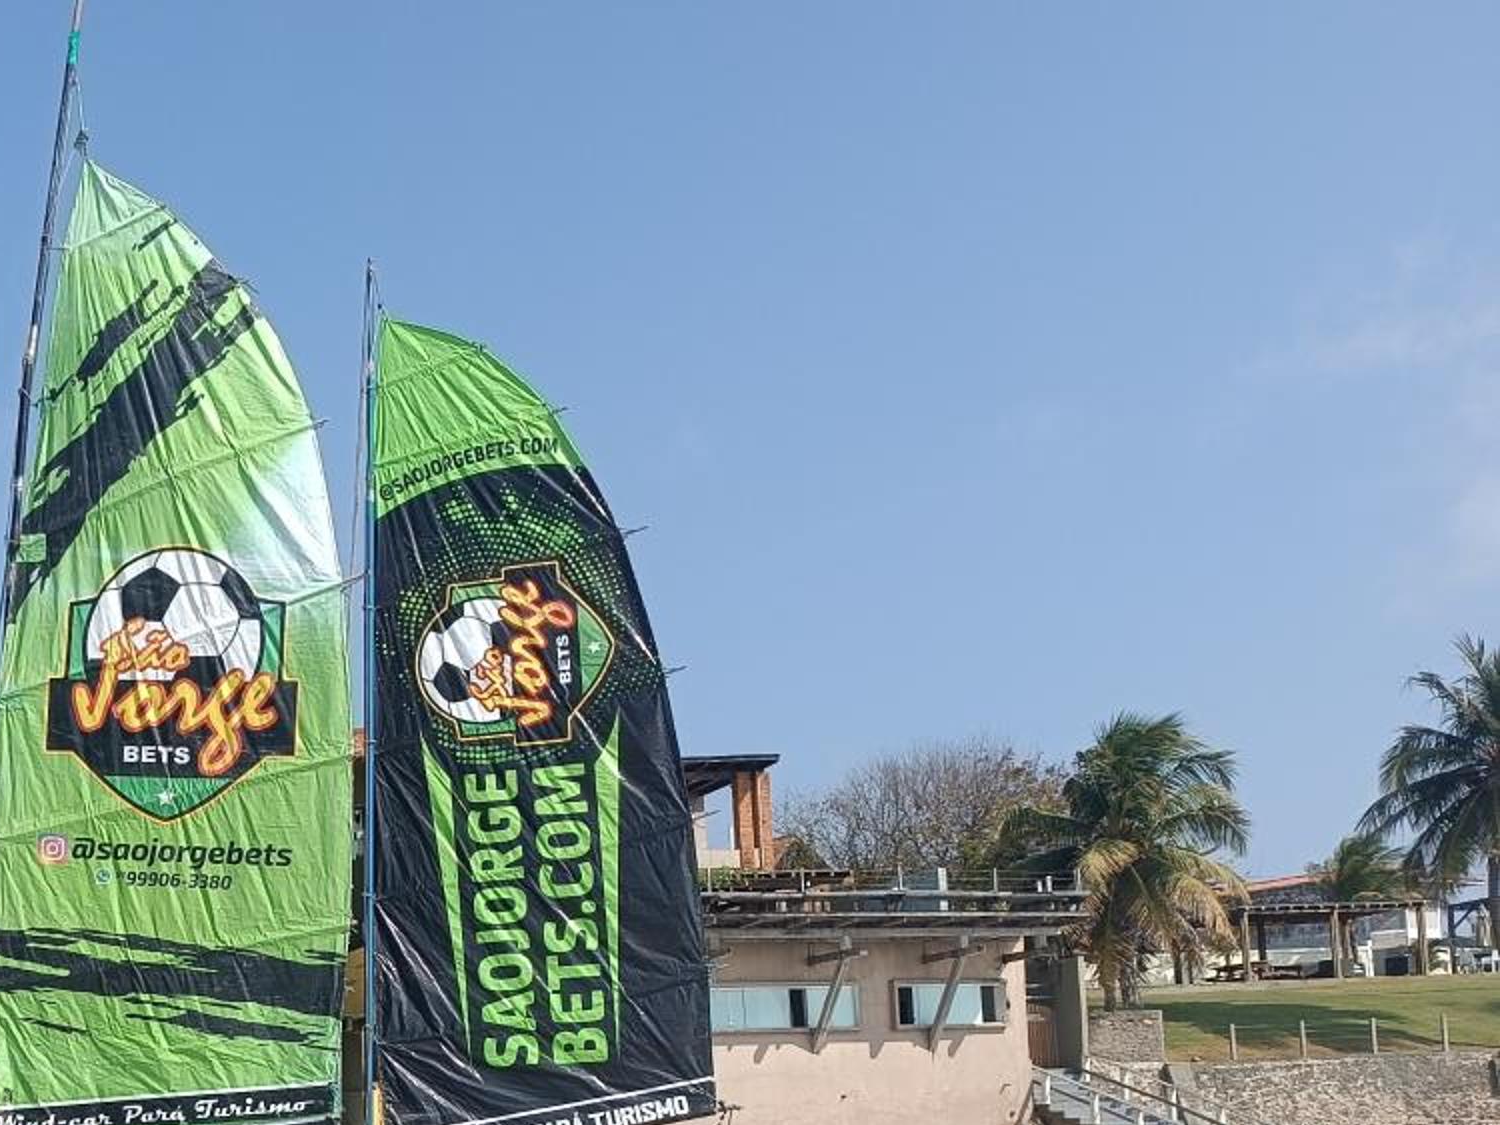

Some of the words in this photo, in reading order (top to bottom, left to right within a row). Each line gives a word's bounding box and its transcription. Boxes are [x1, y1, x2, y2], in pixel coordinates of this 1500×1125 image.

[379, 436, 560, 501] @SAOJORGEBETS.COM
[482, 579, 575, 727] Jorge
[555, 633, 573, 685] BETS
[71, 634, 280, 777] Jorge
[122, 744, 191, 766] BETS
[71, 837, 293, 869] @saojorgebets
[464, 768, 540, 1069] SAOJORGE
[531, 762, 611, 1066] BETS.COM
[195, 1096, 315, 1121] Turismo
